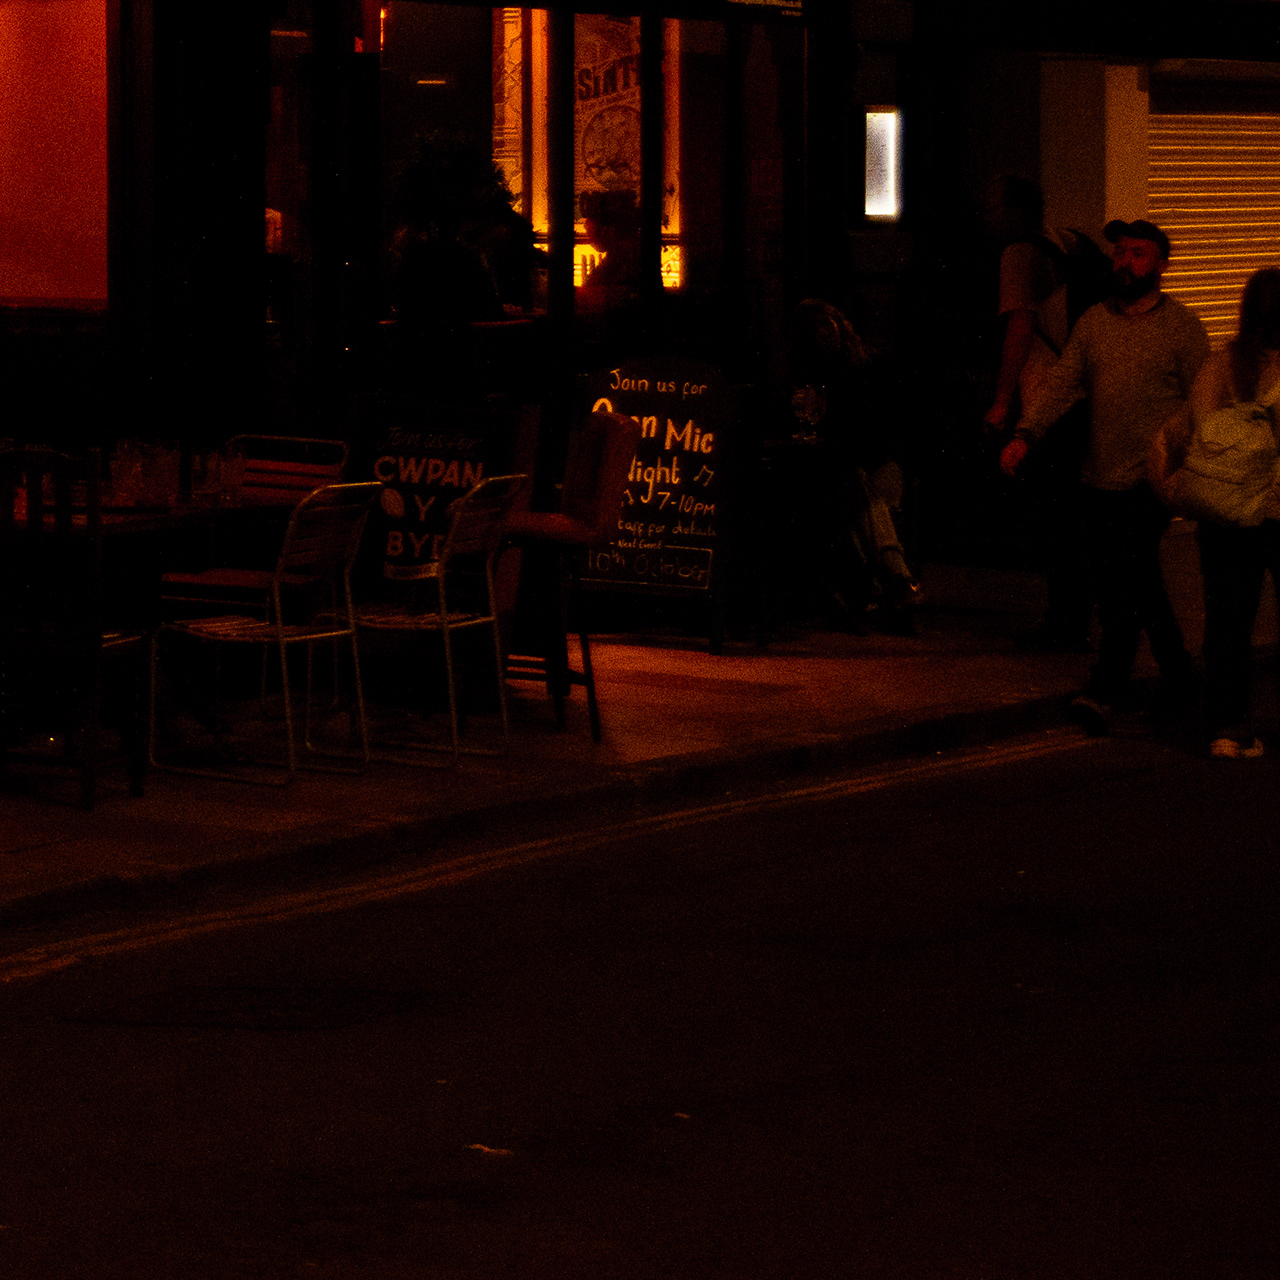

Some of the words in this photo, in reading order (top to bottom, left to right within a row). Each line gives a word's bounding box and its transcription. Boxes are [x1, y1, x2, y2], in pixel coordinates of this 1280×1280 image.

[609, 368, 649, 391] Join
[656, 380, 676, 393] us
[682, 381, 708, 400] for
[424, 433, 444, 449] us
[591, 397, 657, 438] On
[664, 418, 714, 454] Mic
[373, 455, 484, 489] CWPAN
[413, 493, 437, 523] Y
[647, 522, 667, 537] for
